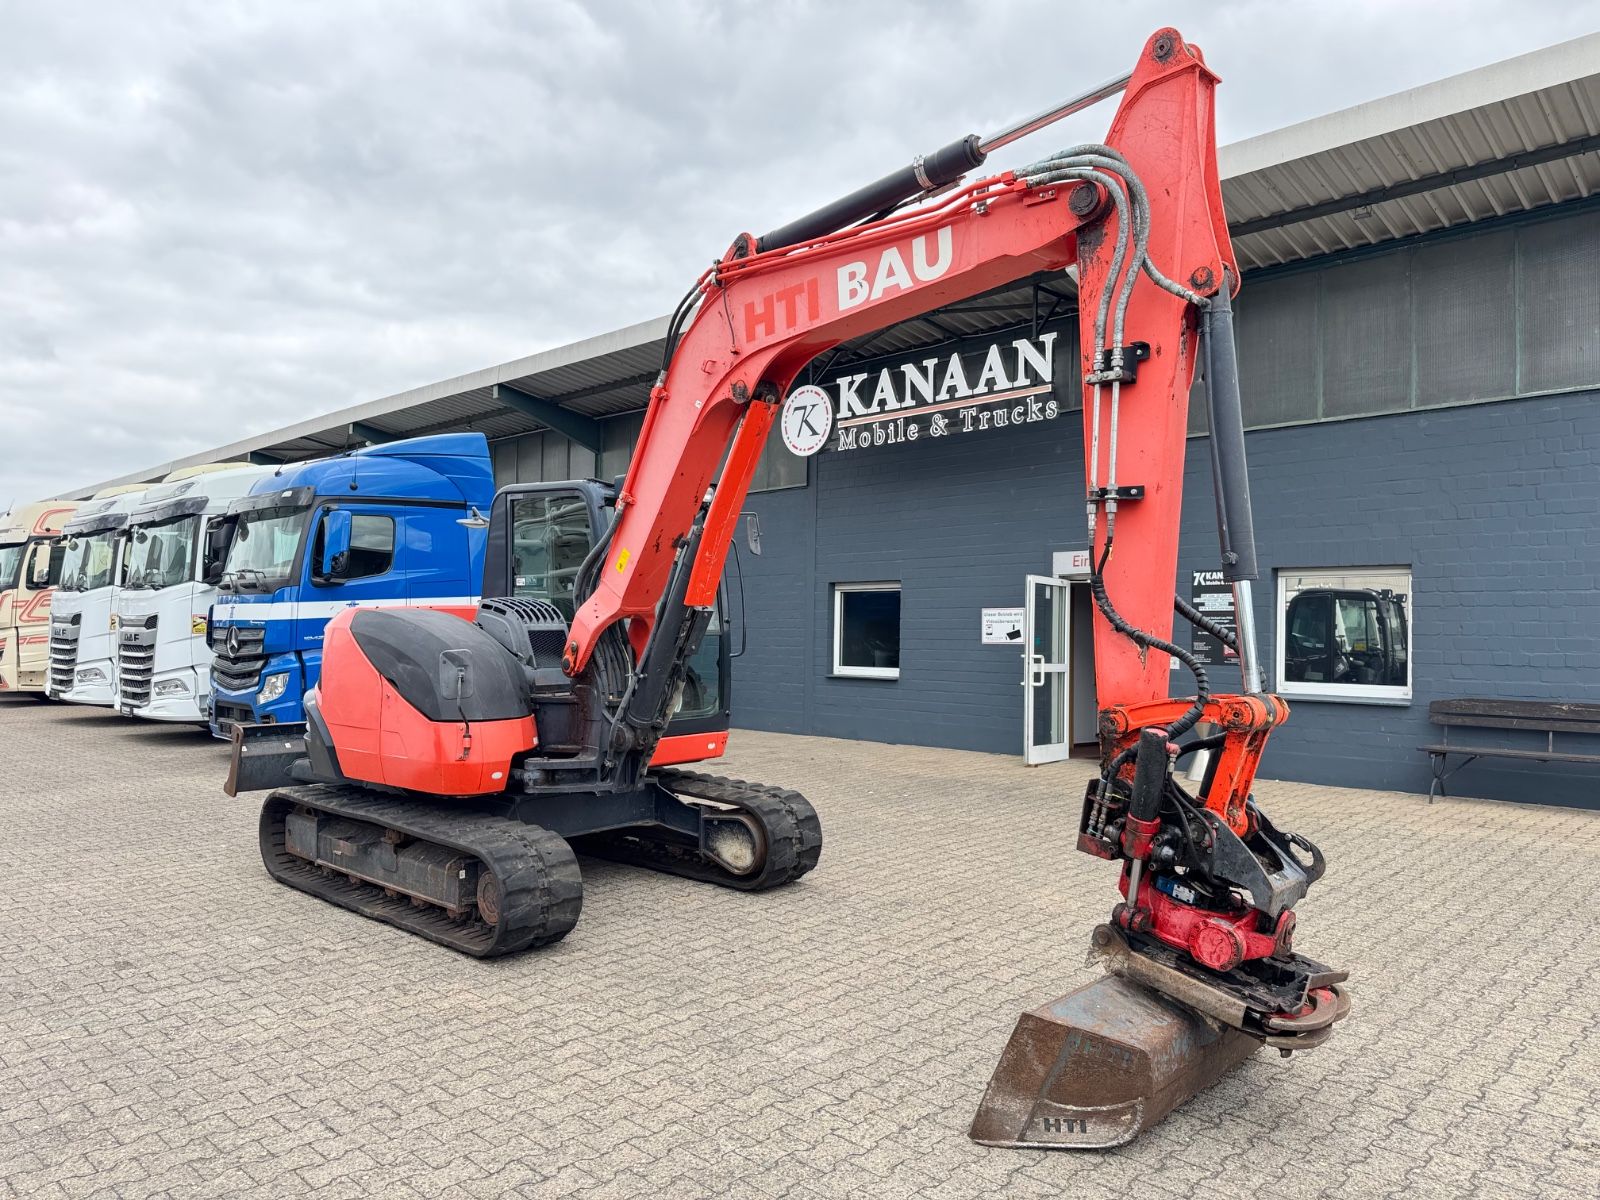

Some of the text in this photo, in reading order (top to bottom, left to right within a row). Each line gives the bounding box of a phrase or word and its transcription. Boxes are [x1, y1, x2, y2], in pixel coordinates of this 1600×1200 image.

[744, 225, 953, 343] HTI BAU
[836, 332, 1057, 419] KANAAN
[838, 396, 1058, 451] Mobile & Trucks
[124, 633, 139, 642] DAF
[1043, 1117, 1087, 1134] HTI
